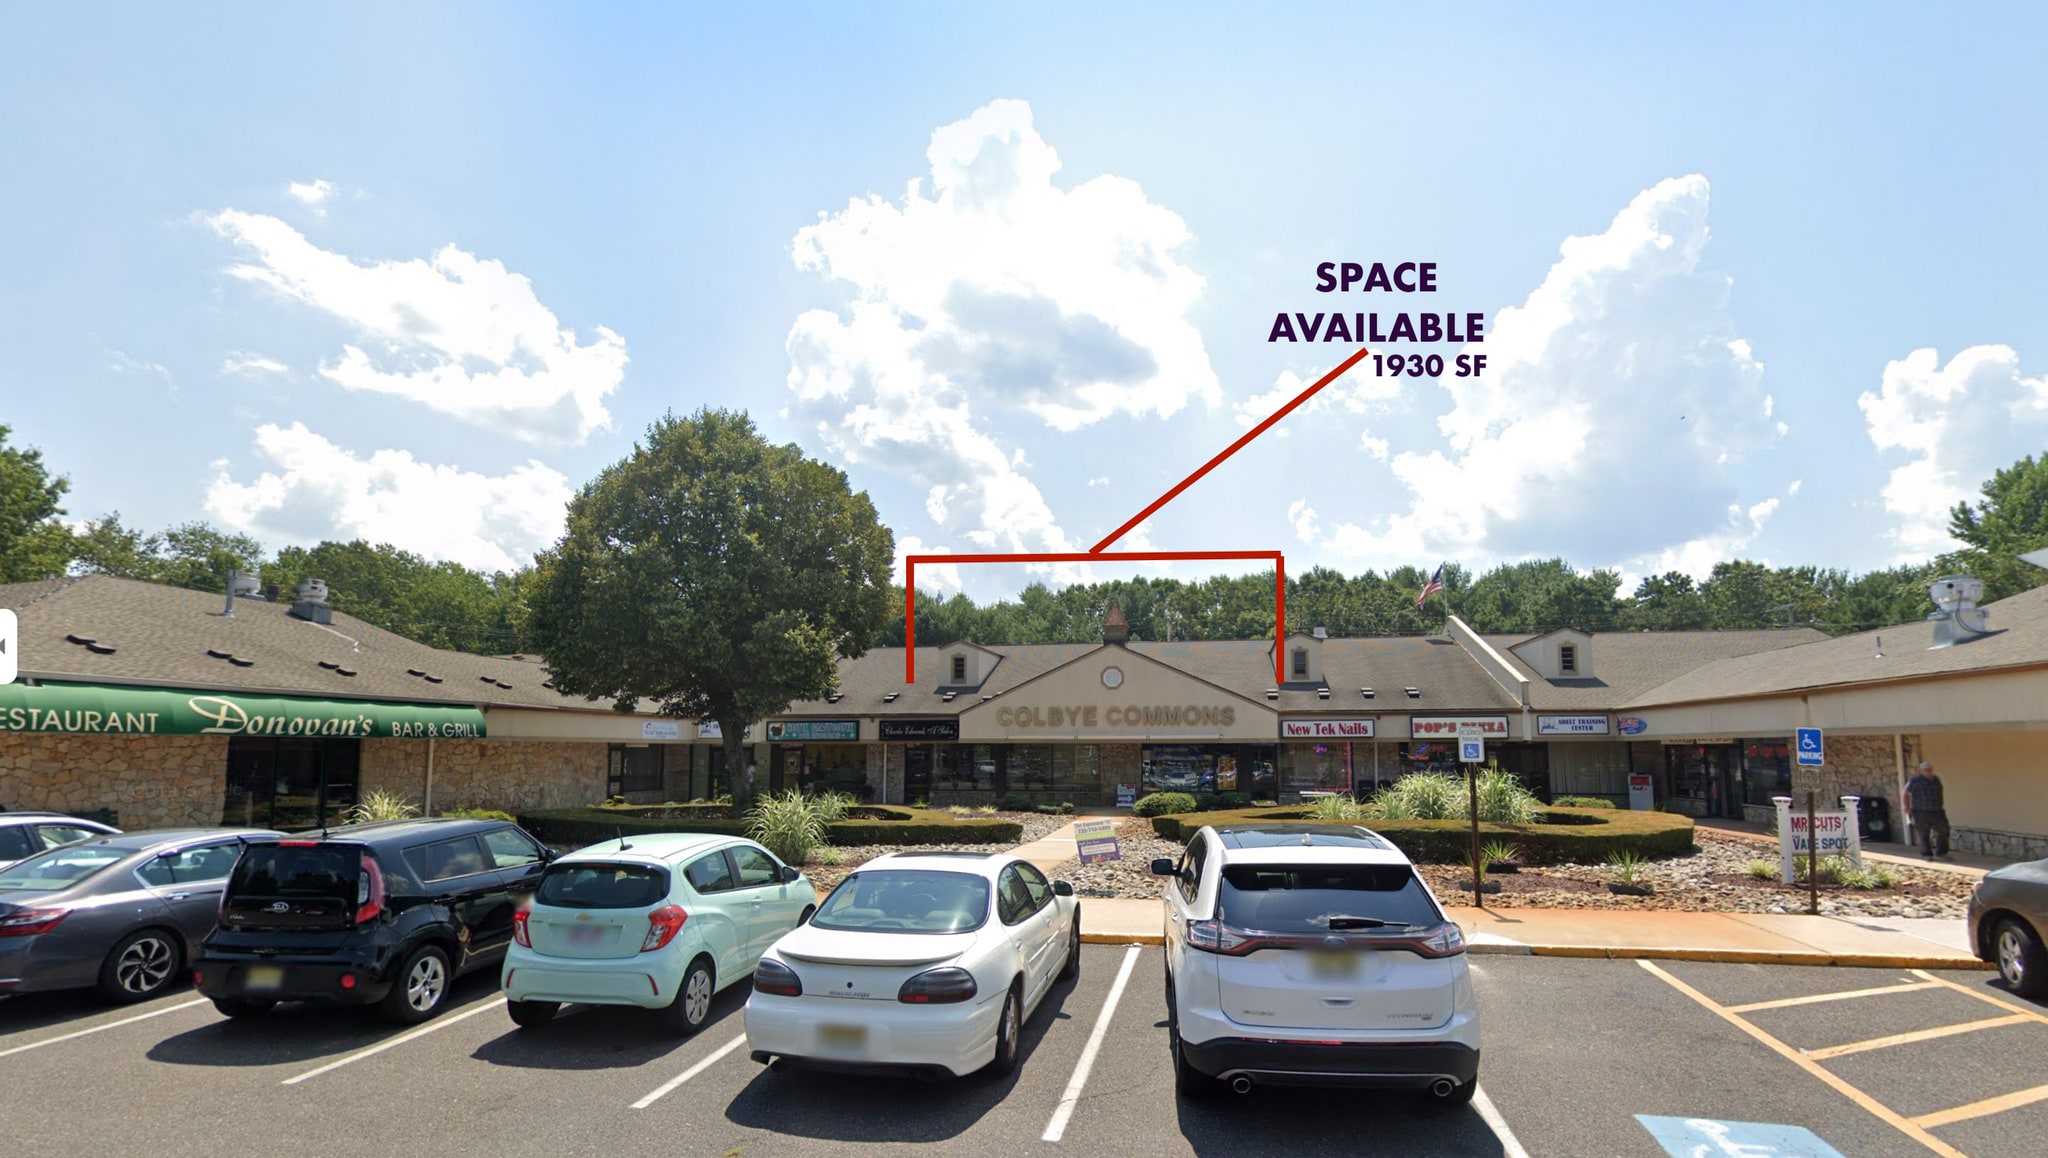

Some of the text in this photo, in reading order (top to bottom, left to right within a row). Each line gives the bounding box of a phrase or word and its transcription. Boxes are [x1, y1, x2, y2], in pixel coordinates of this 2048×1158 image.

[188, 696, 480, 738] Donovan's BAR & GRILL
[997, 706, 1235, 727] COLBYE COMMONS
[1287, 722, 1368, 735] New Tek Nails
[1414, 722, 1457, 733] POP'S
[1814, 817, 1842, 829] CUTS
[1821, 838, 1848, 850] SPOT
